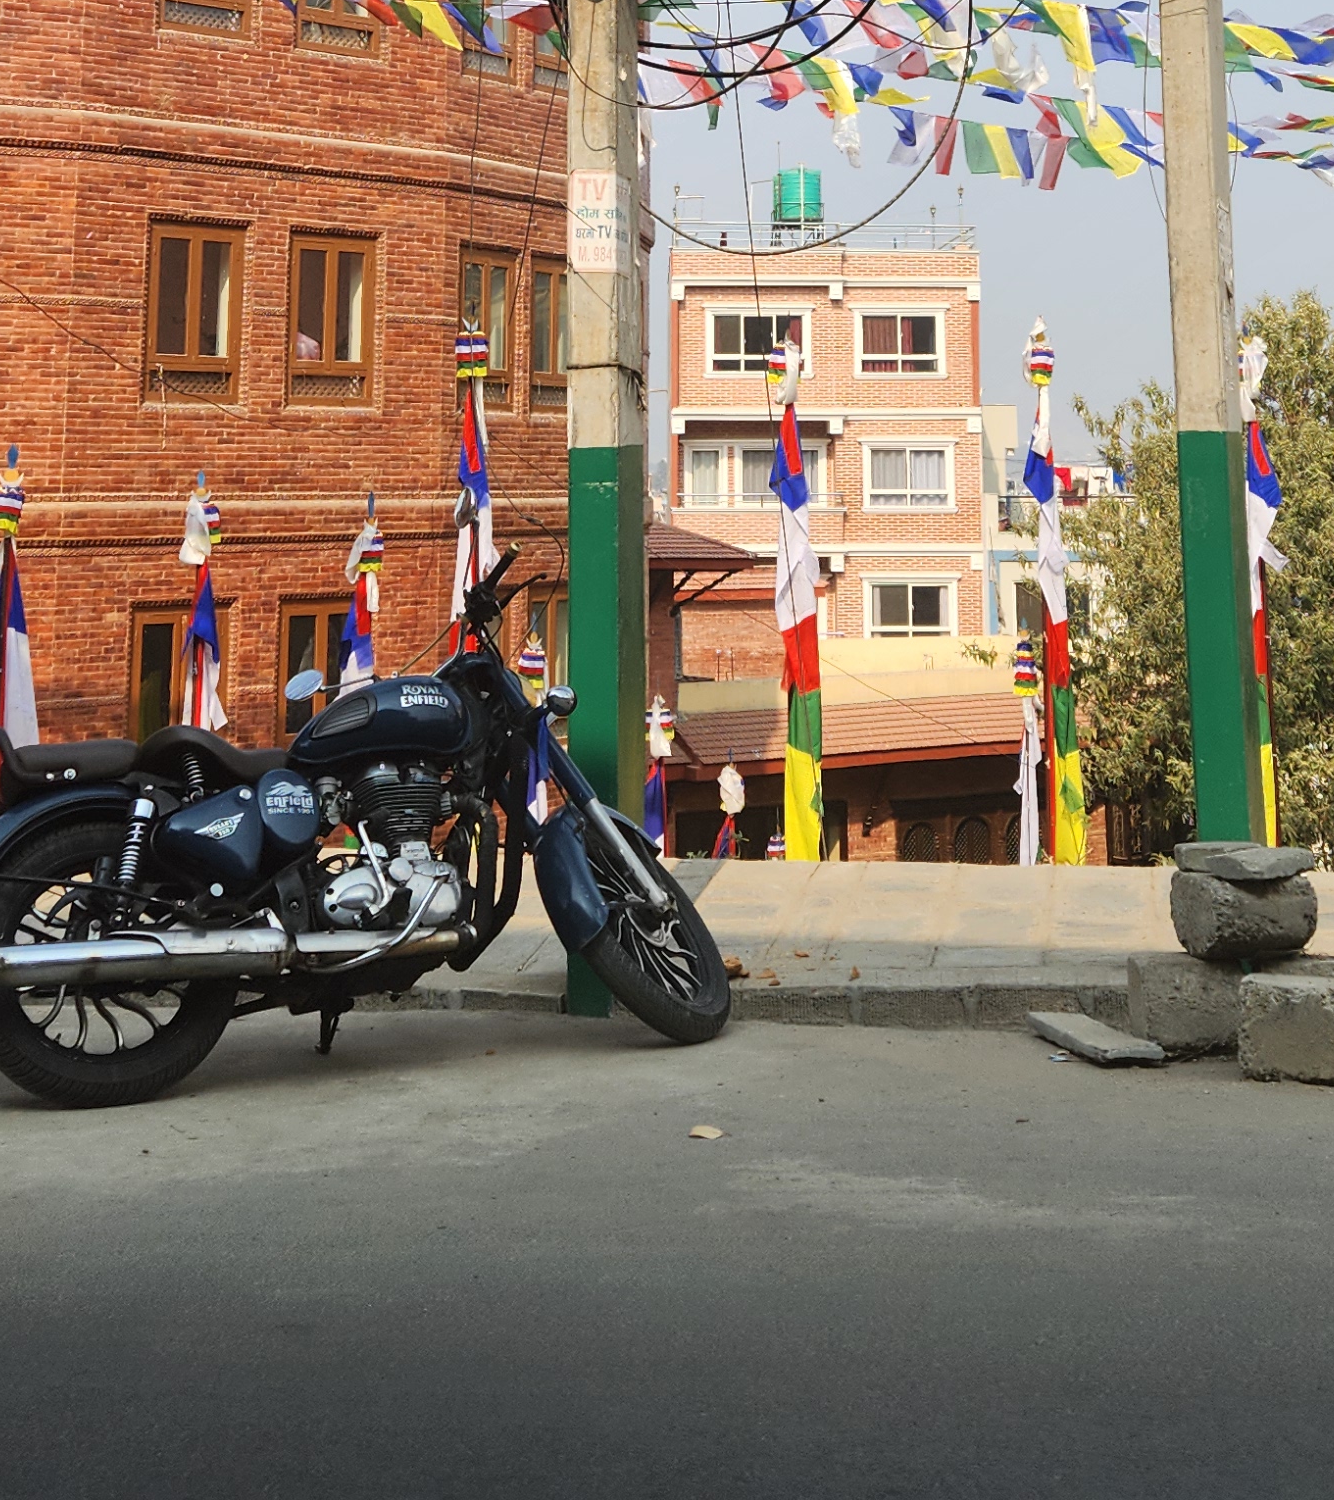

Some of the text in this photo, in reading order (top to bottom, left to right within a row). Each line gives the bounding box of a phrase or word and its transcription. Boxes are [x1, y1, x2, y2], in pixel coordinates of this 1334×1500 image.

[578, 178, 608, 201] TV
[597, 225, 612, 239] TV
[401, 684, 442, 695] ROYAL
[400, 695, 449, 709] ENFIELD
[267, 807, 295, 815] SINCE
